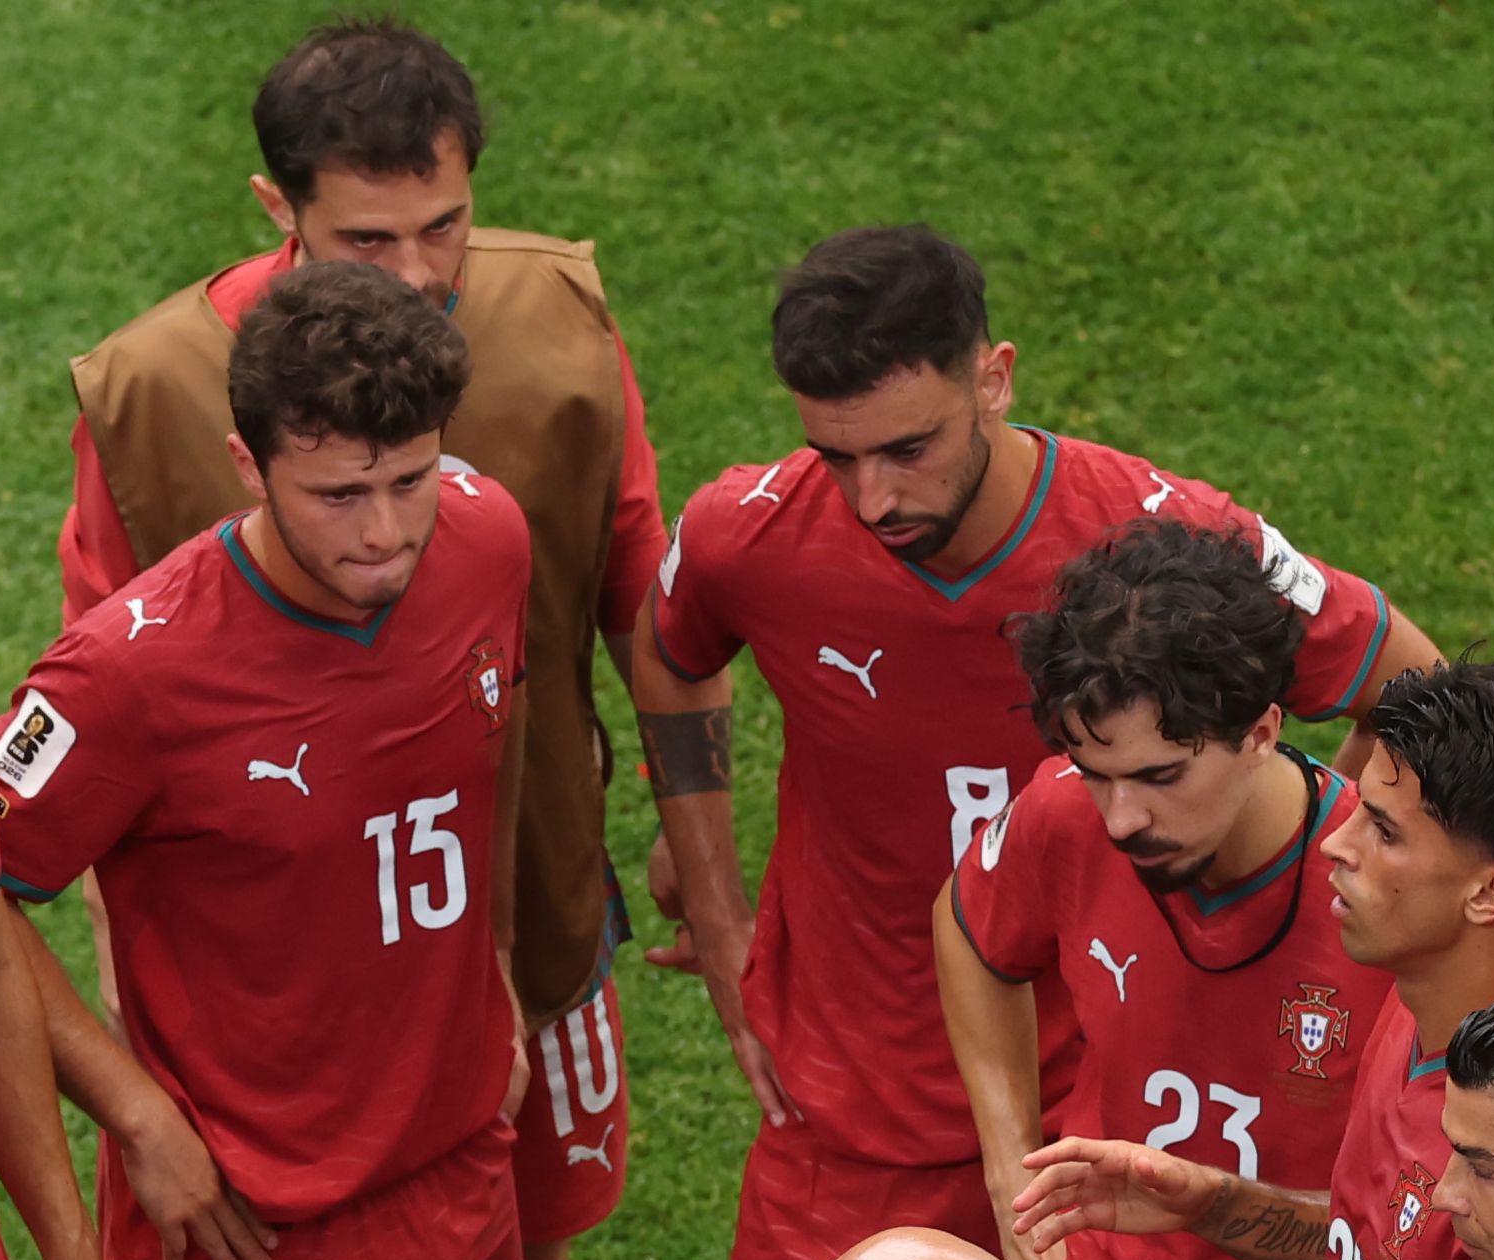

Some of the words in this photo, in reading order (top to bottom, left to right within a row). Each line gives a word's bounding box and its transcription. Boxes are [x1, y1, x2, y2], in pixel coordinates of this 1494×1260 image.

[364, 789, 467, 945] 15
[945, 765, 1009, 869] 8
[540, 989, 619, 1139] 10
[1144, 1069, 1261, 1181] 23
